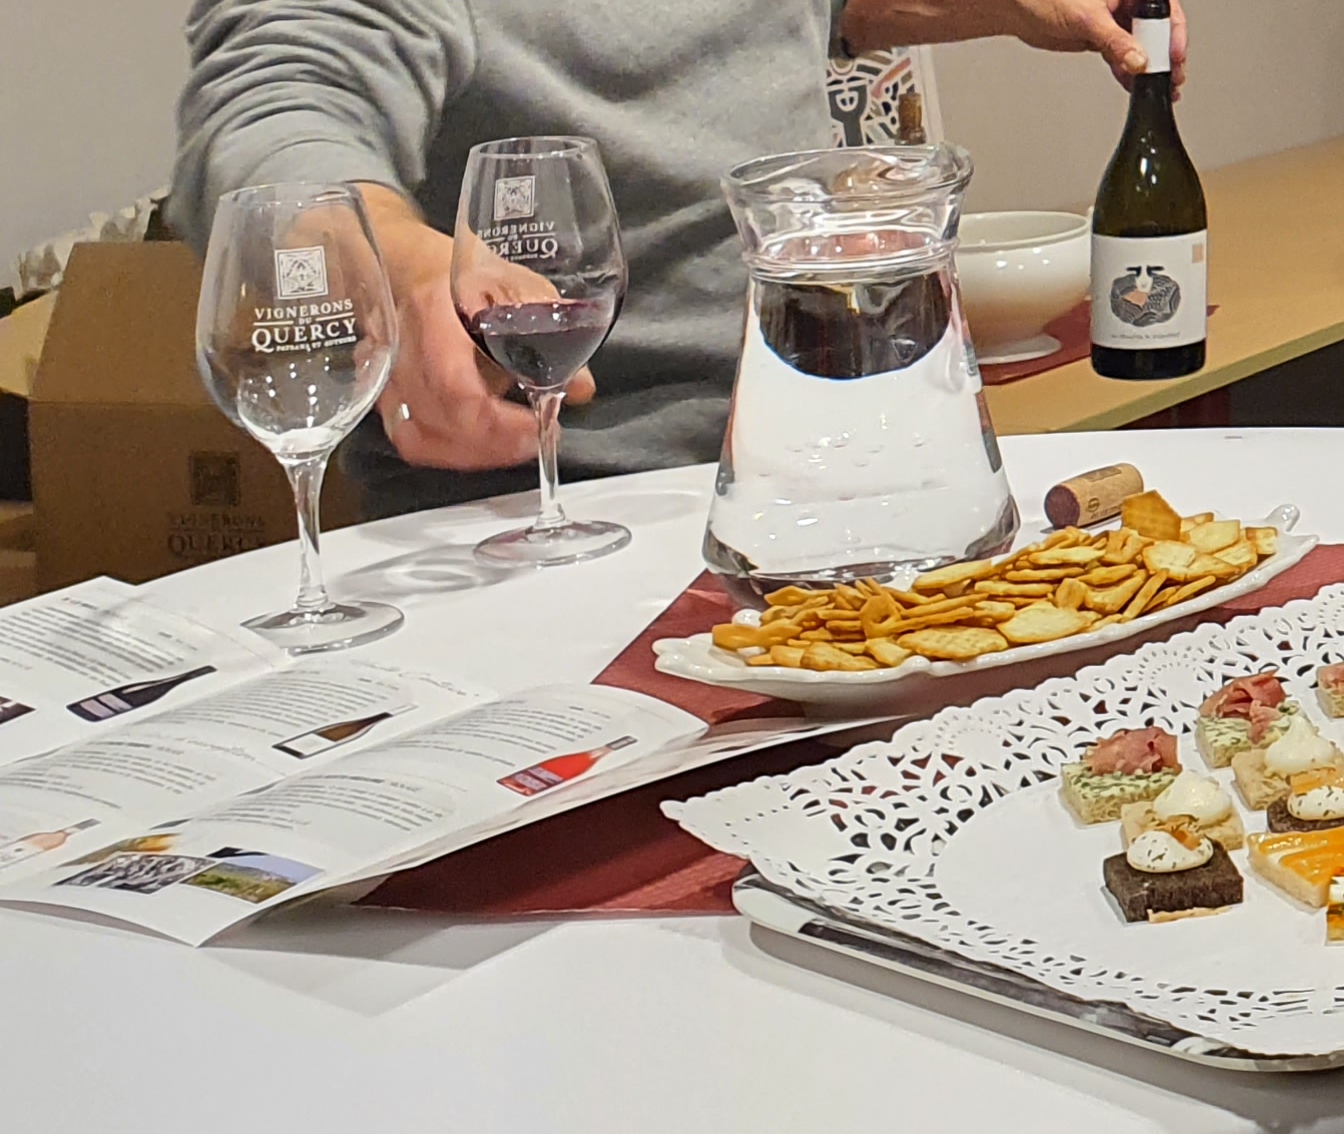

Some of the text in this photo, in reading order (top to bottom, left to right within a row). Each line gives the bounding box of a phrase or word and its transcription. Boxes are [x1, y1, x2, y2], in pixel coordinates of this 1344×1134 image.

[254, 299, 353, 320] VIGNERONS
[298, 317, 312, 325] DU
[251, 318, 356, 353] QUERCY
